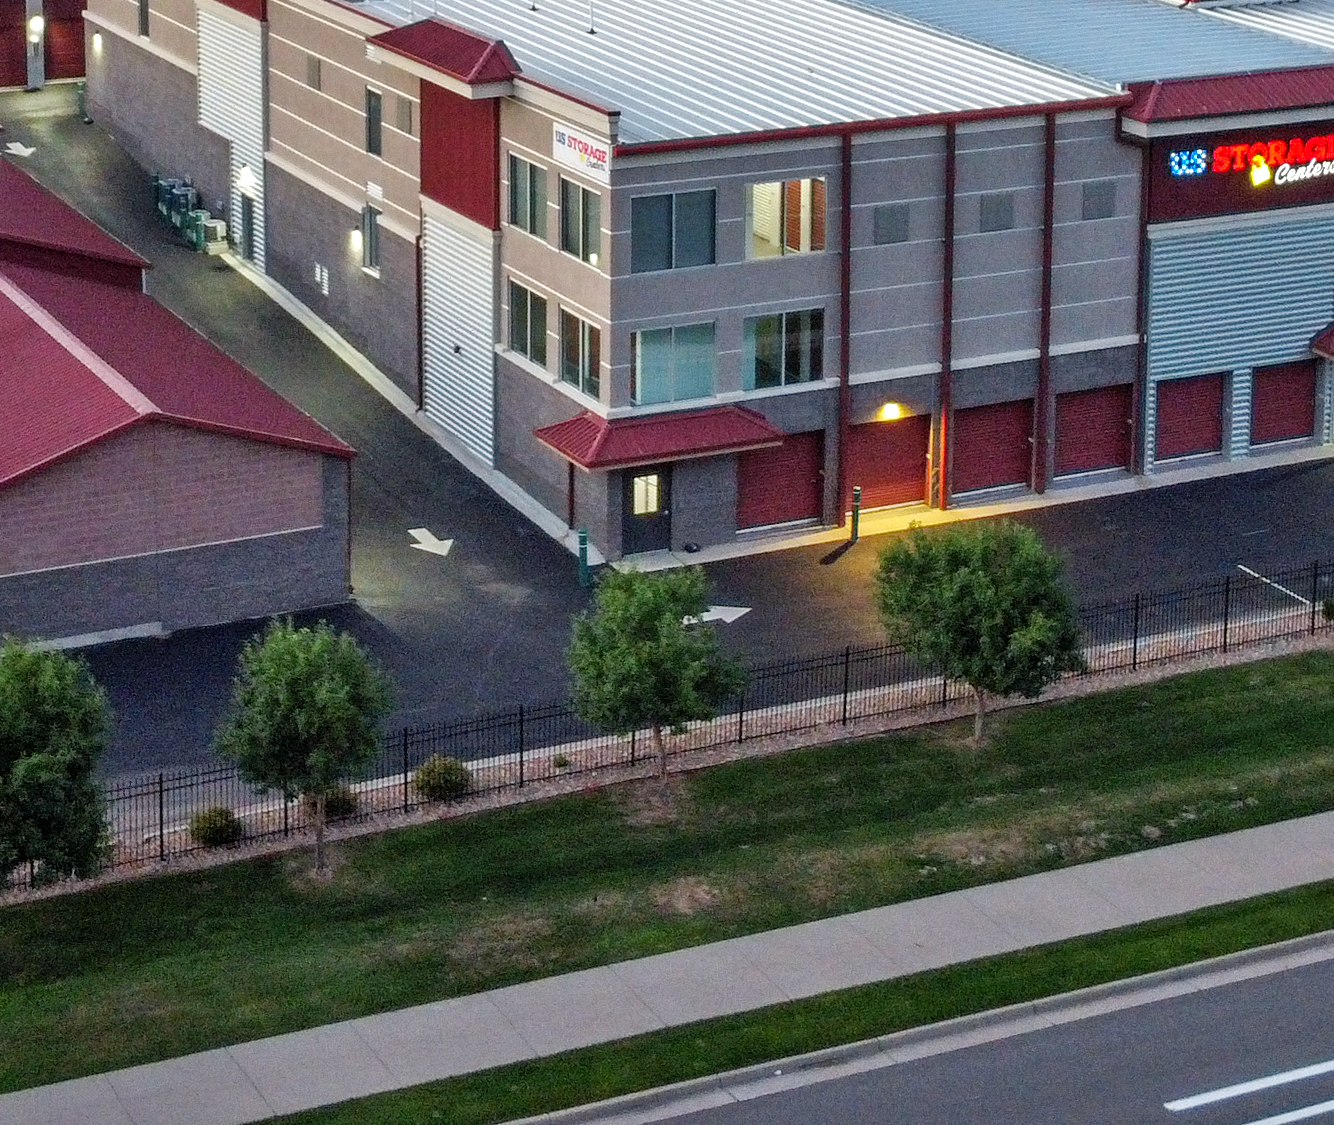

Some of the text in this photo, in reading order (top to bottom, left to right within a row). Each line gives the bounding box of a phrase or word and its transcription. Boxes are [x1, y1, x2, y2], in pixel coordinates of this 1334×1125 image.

[555, 130, 607, 163] US STORAGE
[1170, 148, 1208, 176] US
